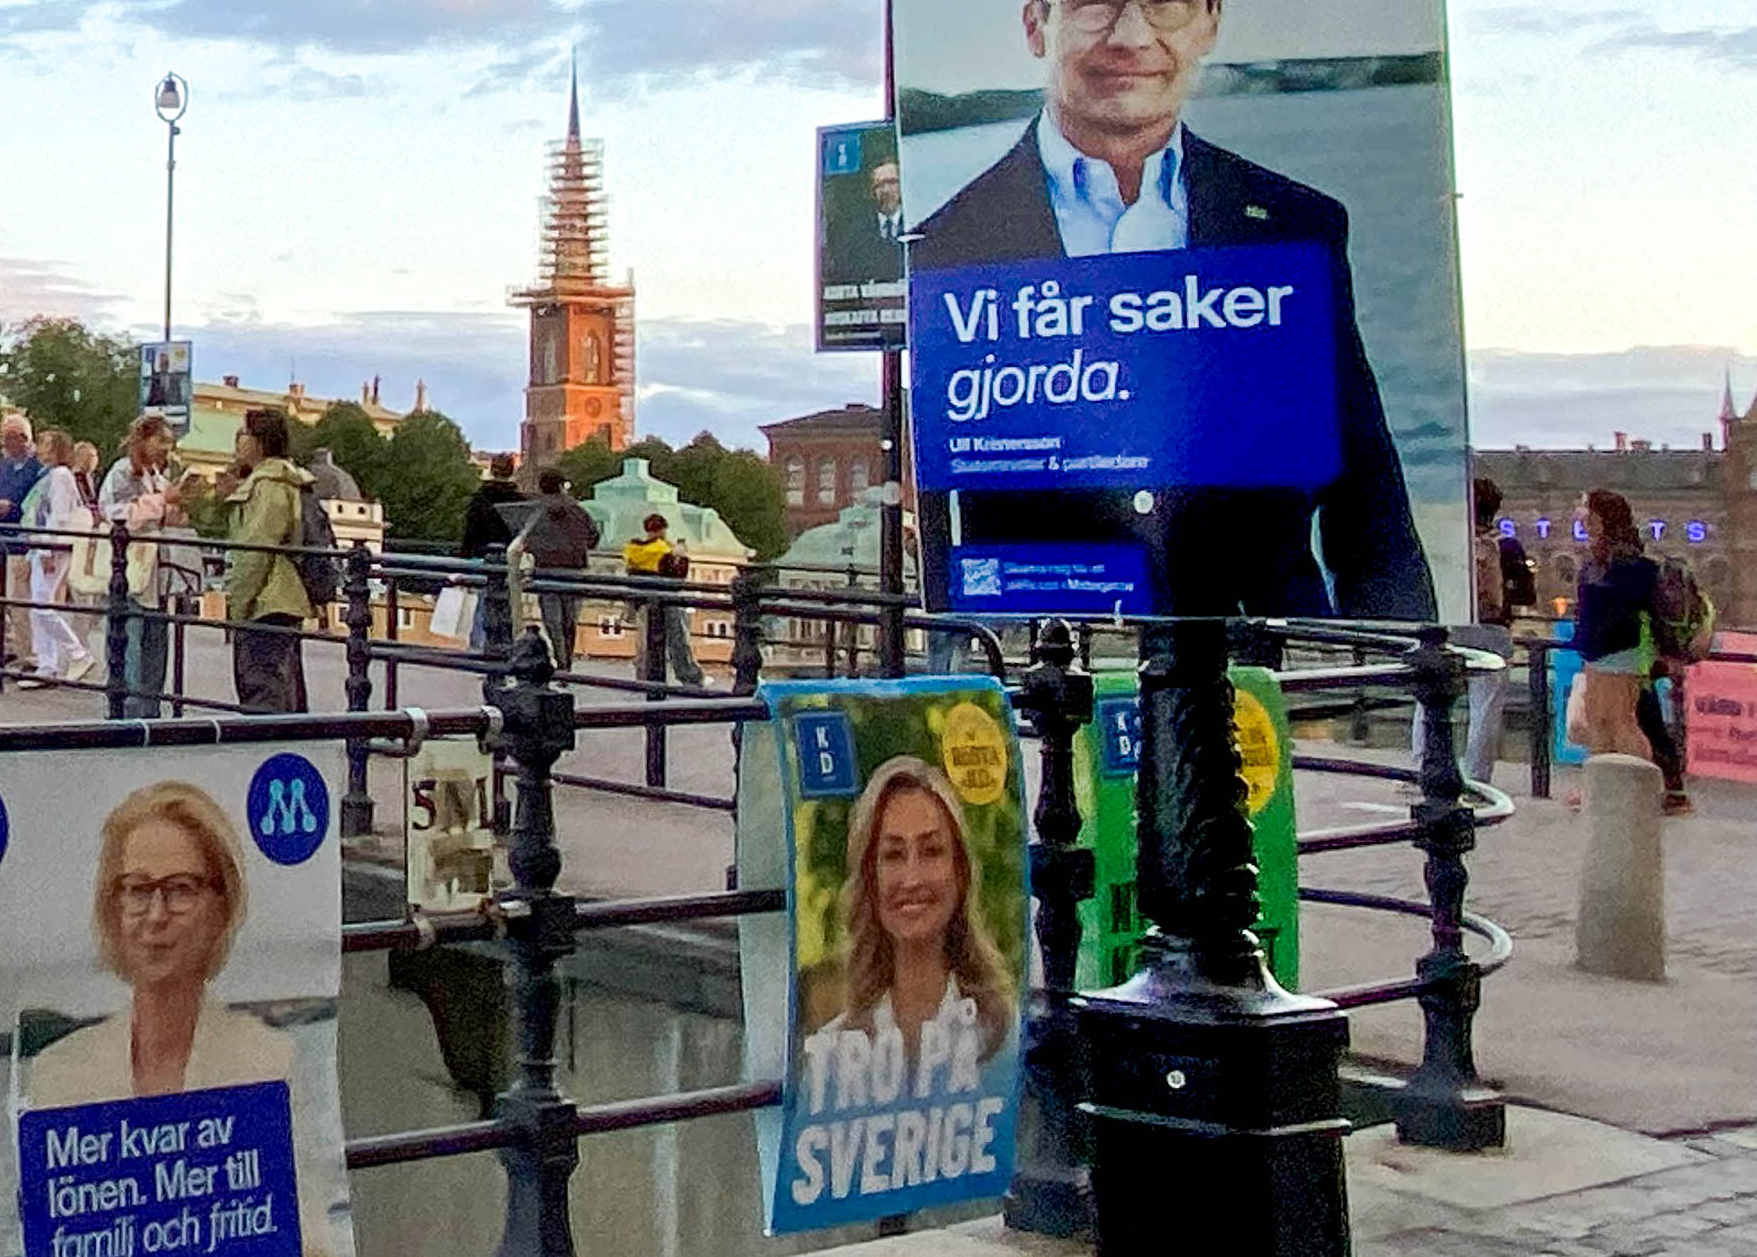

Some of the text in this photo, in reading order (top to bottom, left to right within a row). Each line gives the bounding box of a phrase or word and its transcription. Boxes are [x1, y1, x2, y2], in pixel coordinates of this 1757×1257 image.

[943, 274, 1294, 343] Vi får saker
[947, 348, 1130, 422] gjorda.
[46, 1115, 236, 1169] Mer kvar av
[792, 1097, 1004, 1205] SVERIGE
[48, 1149, 261, 1218] lönen. Mer till
[144, 1207, 200, 1253] och
[202, 1194, 278, 1253] fritid.
